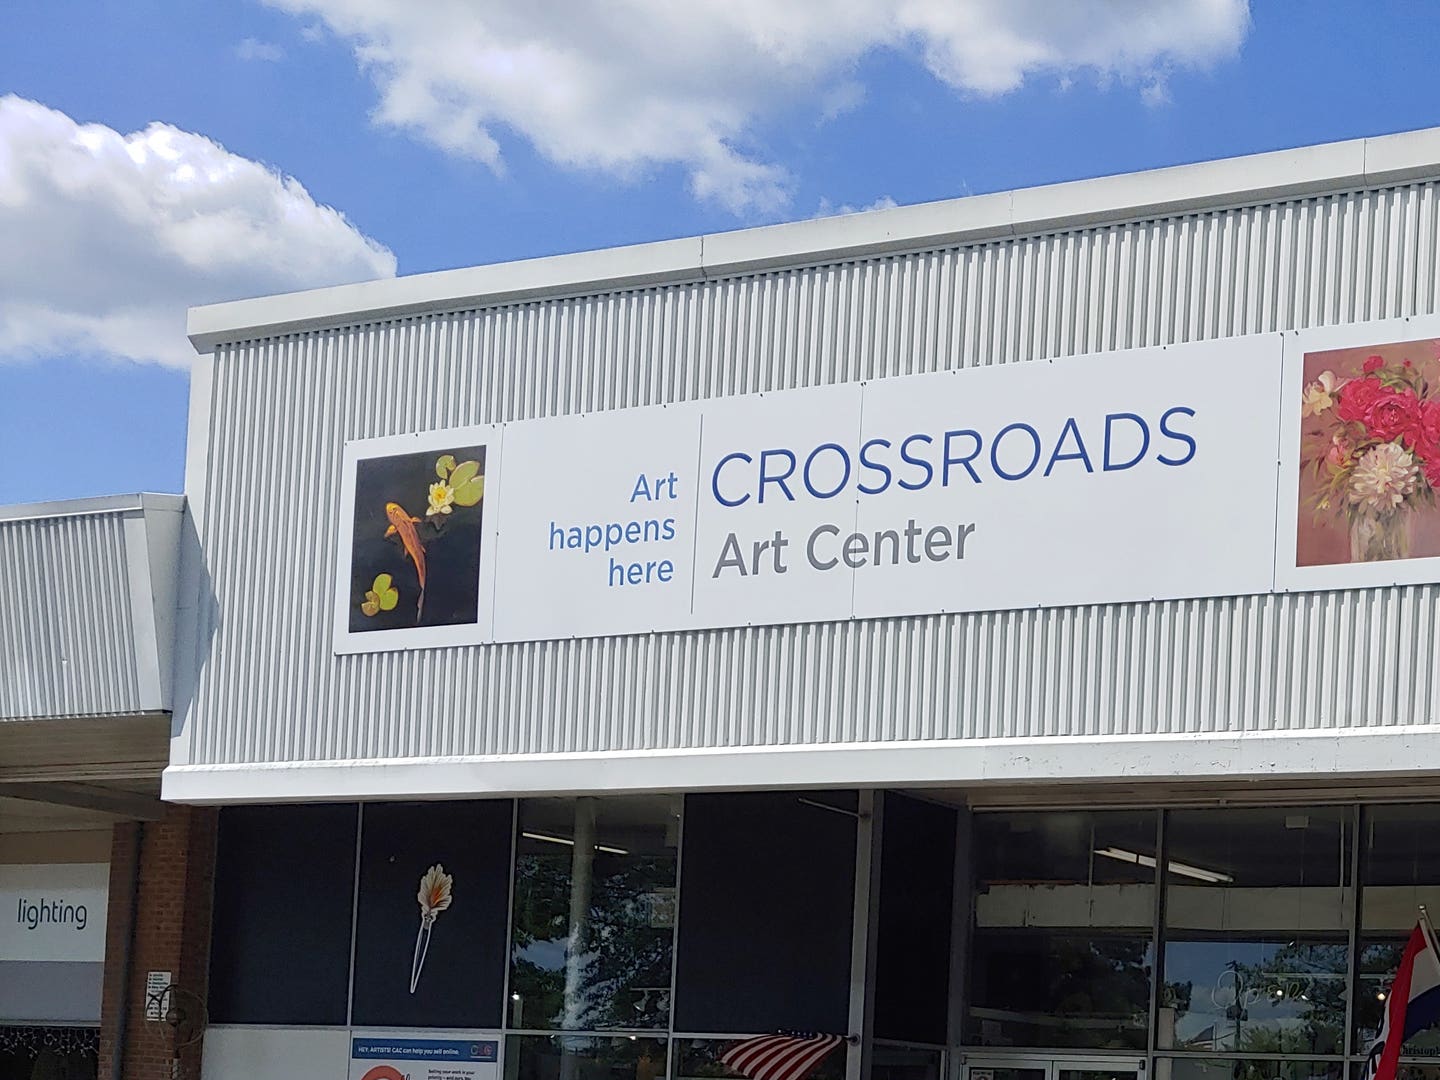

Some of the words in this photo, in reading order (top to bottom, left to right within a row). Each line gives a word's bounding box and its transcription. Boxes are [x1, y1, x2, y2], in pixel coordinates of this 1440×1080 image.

[711, 406, 1197, 507] CROSSROADS
[630, 471, 678, 503] Art
[549, 517, 676, 553] happens
[711, 531, 789, 579] Art
[805, 518, 976, 571] Center
[608, 557, 674, 587] here
[17, 898, 88, 930] lighting
